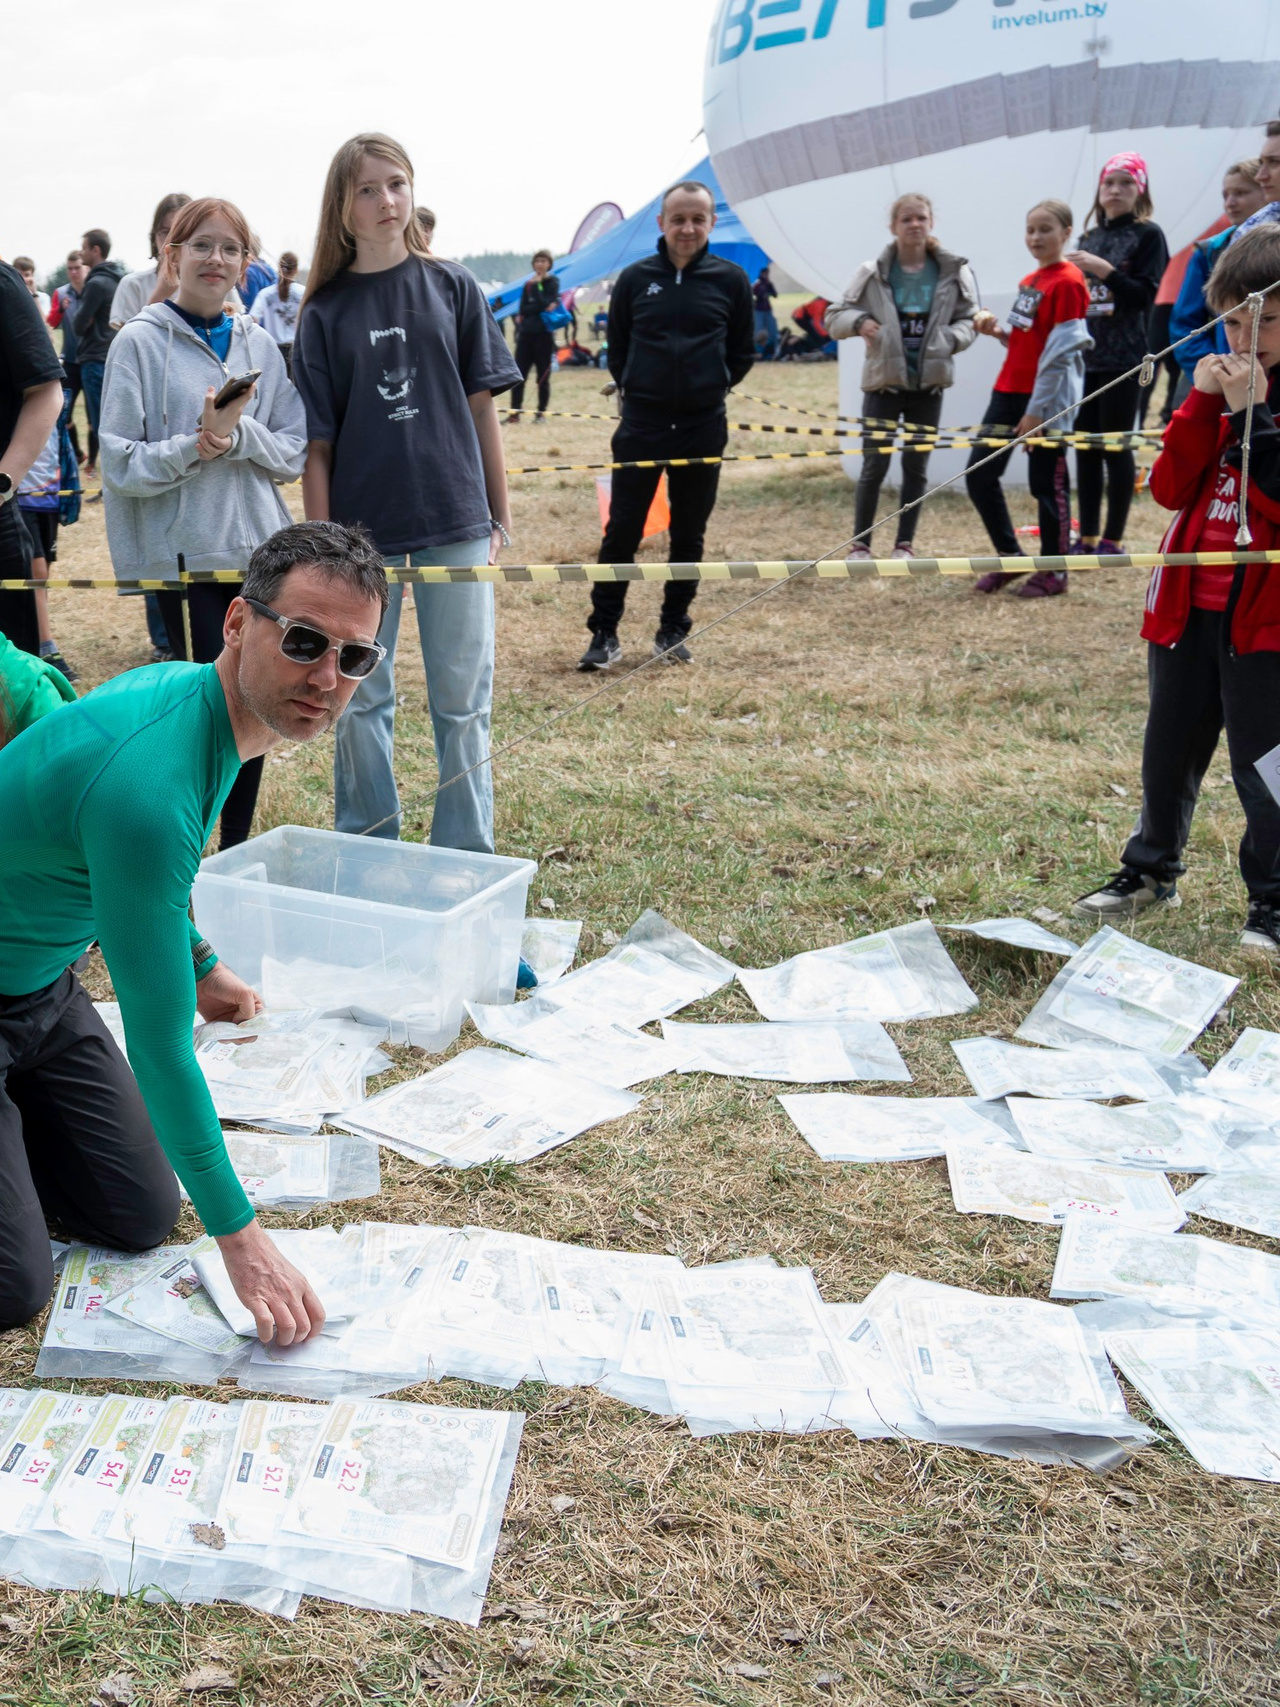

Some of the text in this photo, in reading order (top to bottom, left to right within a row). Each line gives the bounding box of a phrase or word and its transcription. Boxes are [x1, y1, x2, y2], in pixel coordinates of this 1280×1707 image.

[992, 3, 1108, 30] invelum.by
[1090, 284, 1108, 301] 63
[241, 1177, 265, 1188] 7.2
[22, 1458, 51, 1486] 55.1
[95, 1460, 125, 1488] 54.1
[166, 1467, 194, 1497] 53.1
[261, 1465, 284, 1493] 52.1
[337, 1459, 364, 1493] 52.2
